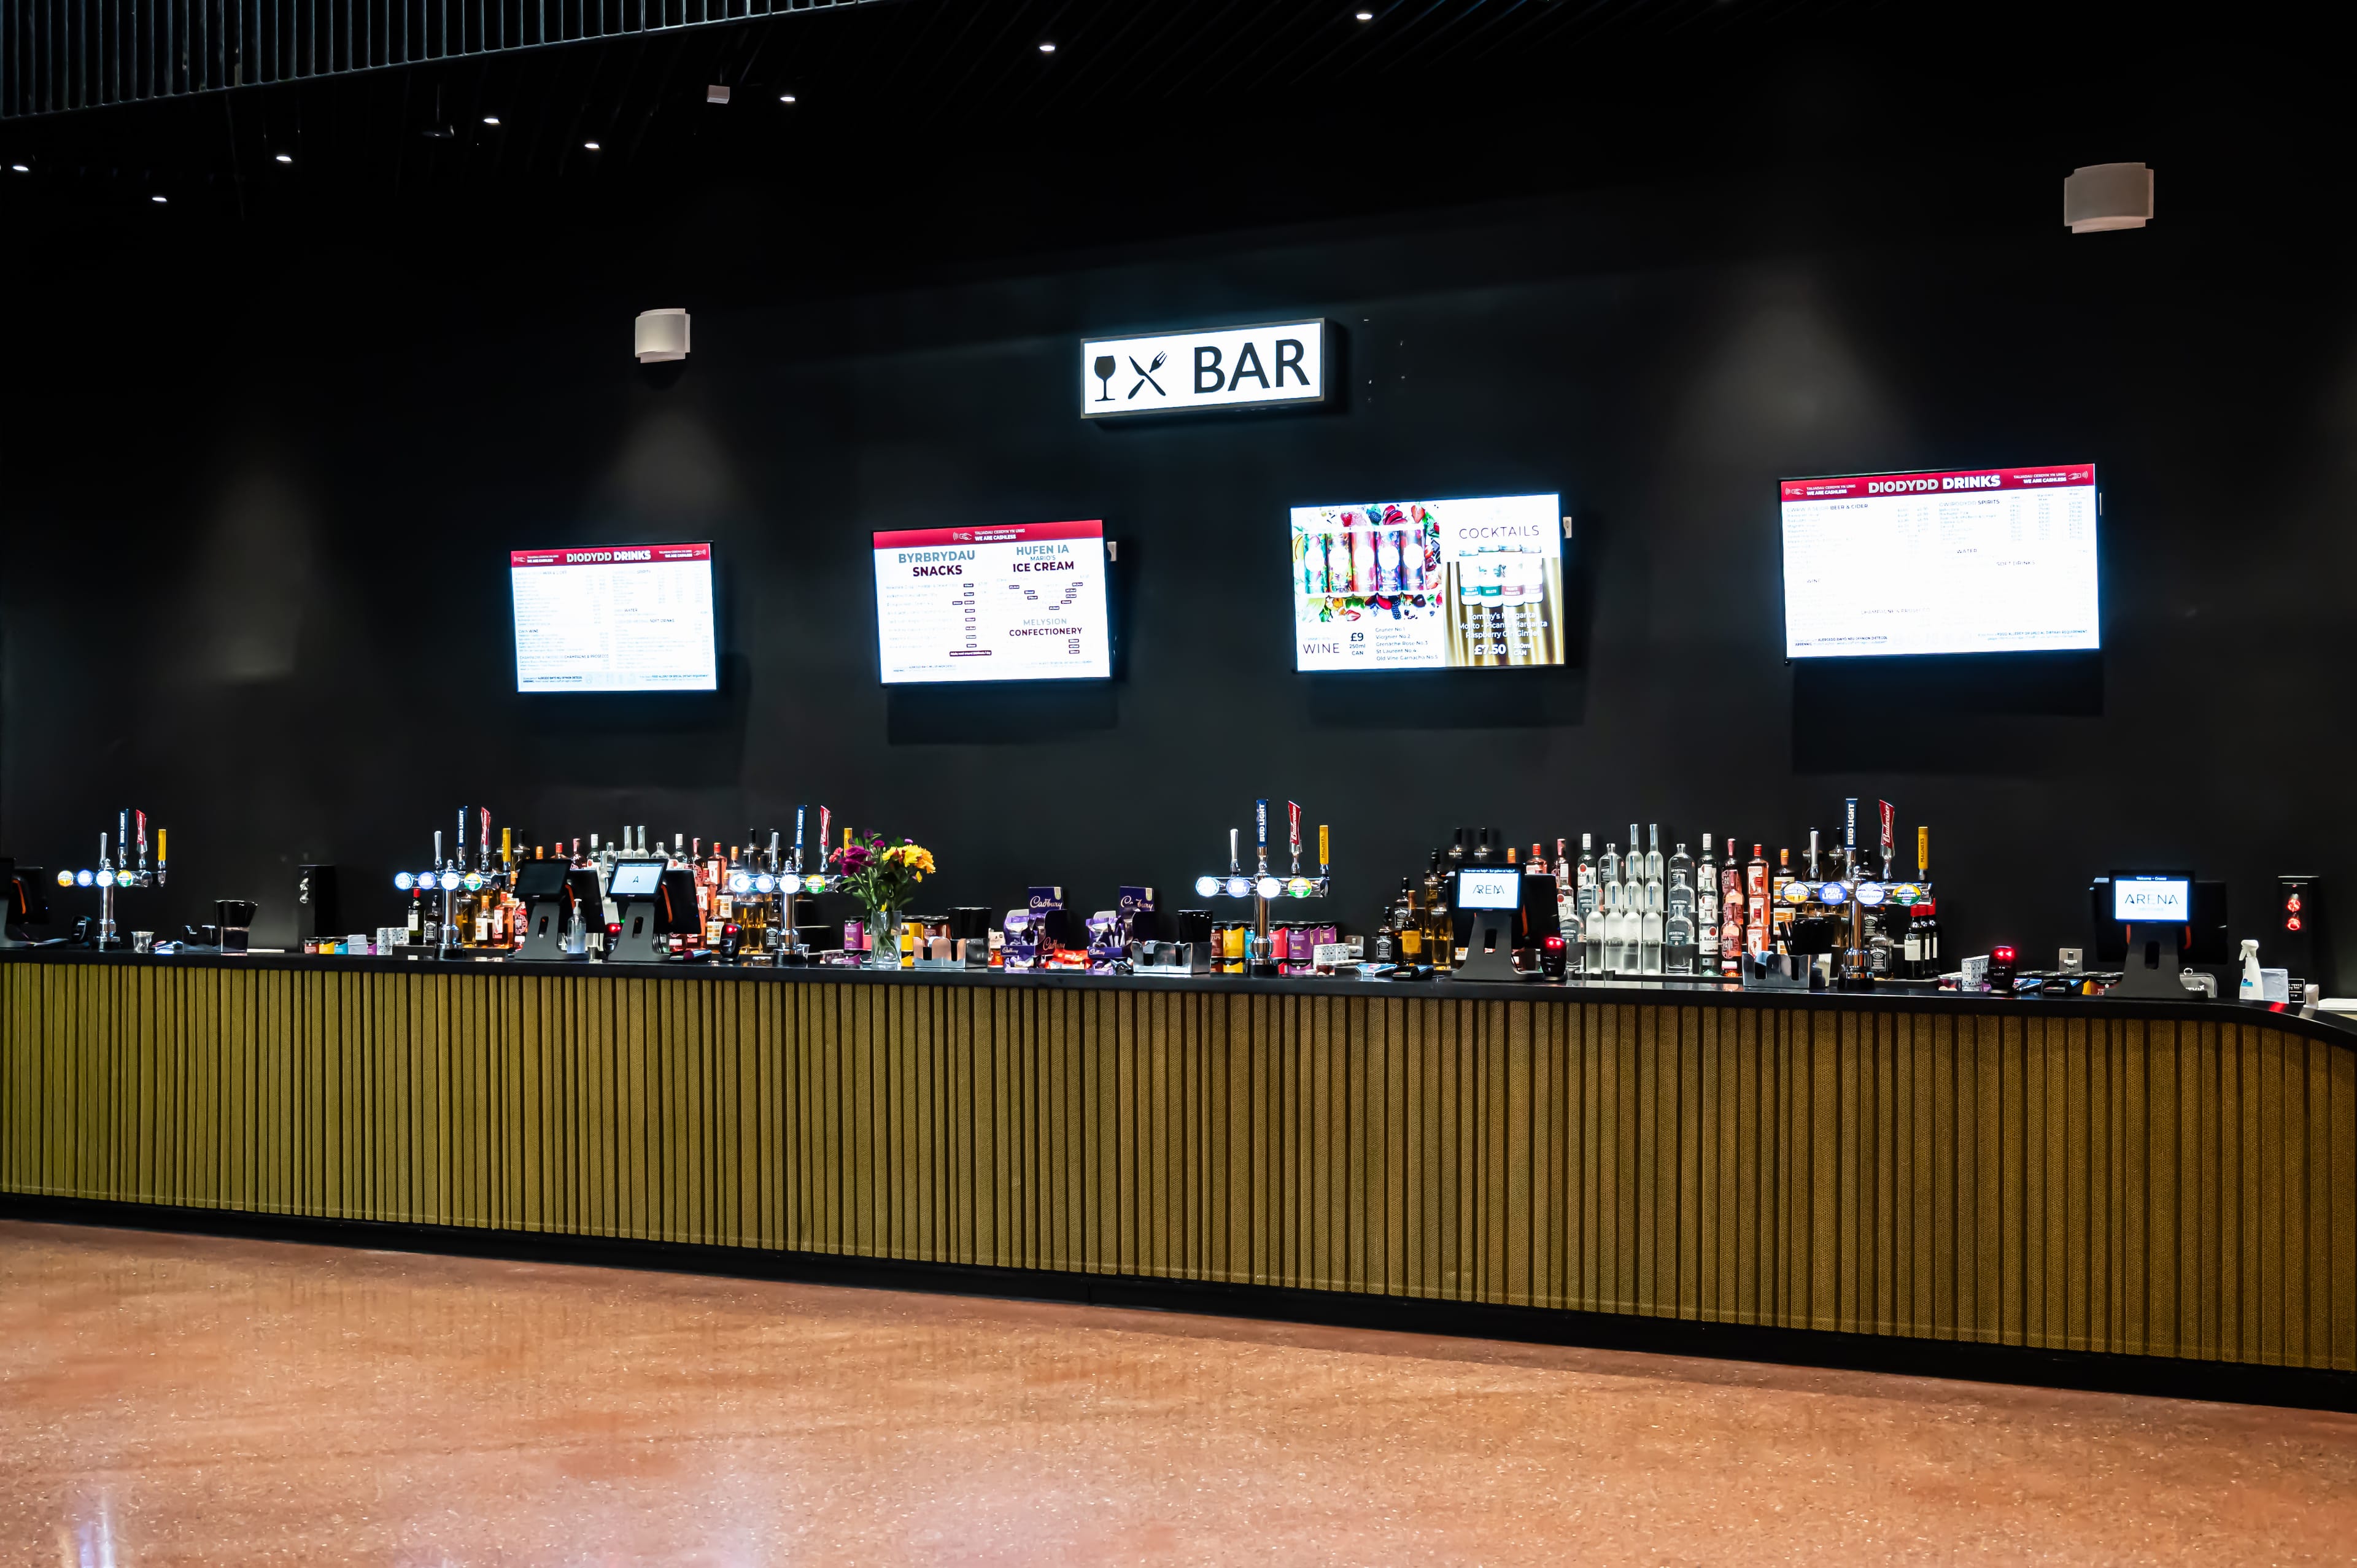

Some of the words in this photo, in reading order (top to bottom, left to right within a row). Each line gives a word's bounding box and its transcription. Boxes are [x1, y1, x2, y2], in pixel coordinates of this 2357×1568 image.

[1194, 339, 1310, 394] BAR
[1868, 479, 1939, 493] DIODYDD
[1942, 474, 2001, 490] DRINKS
[1459, 525, 1539, 539] COCKTAILS
[1016, 545, 1054, 555] HUFEN
[1058, 544, 1070, 554] IA
[567, 552, 613, 563] DIODYDD
[614, 550, 651, 561] DRINKS
[899, 550, 975, 563] BYRBRYDAU
[913, 565, 962, 577] SNACKS
[1013, 563, 1031, 573] ICE
[1034, 561, 1074, 571] CREAM
[1009, 627, 1083, 636] CONFECTIONERY
[1350, 632, 1364, 642] £9
[1302, 643, 1340, 654] WINE
[1474, 644, 1506, 655] £7.50
[1029, 895, 1063, 910] Cadbury
[2124, 894, 2178, 905] ARENA
[1043, 937, 1066, 951] Cadbury
